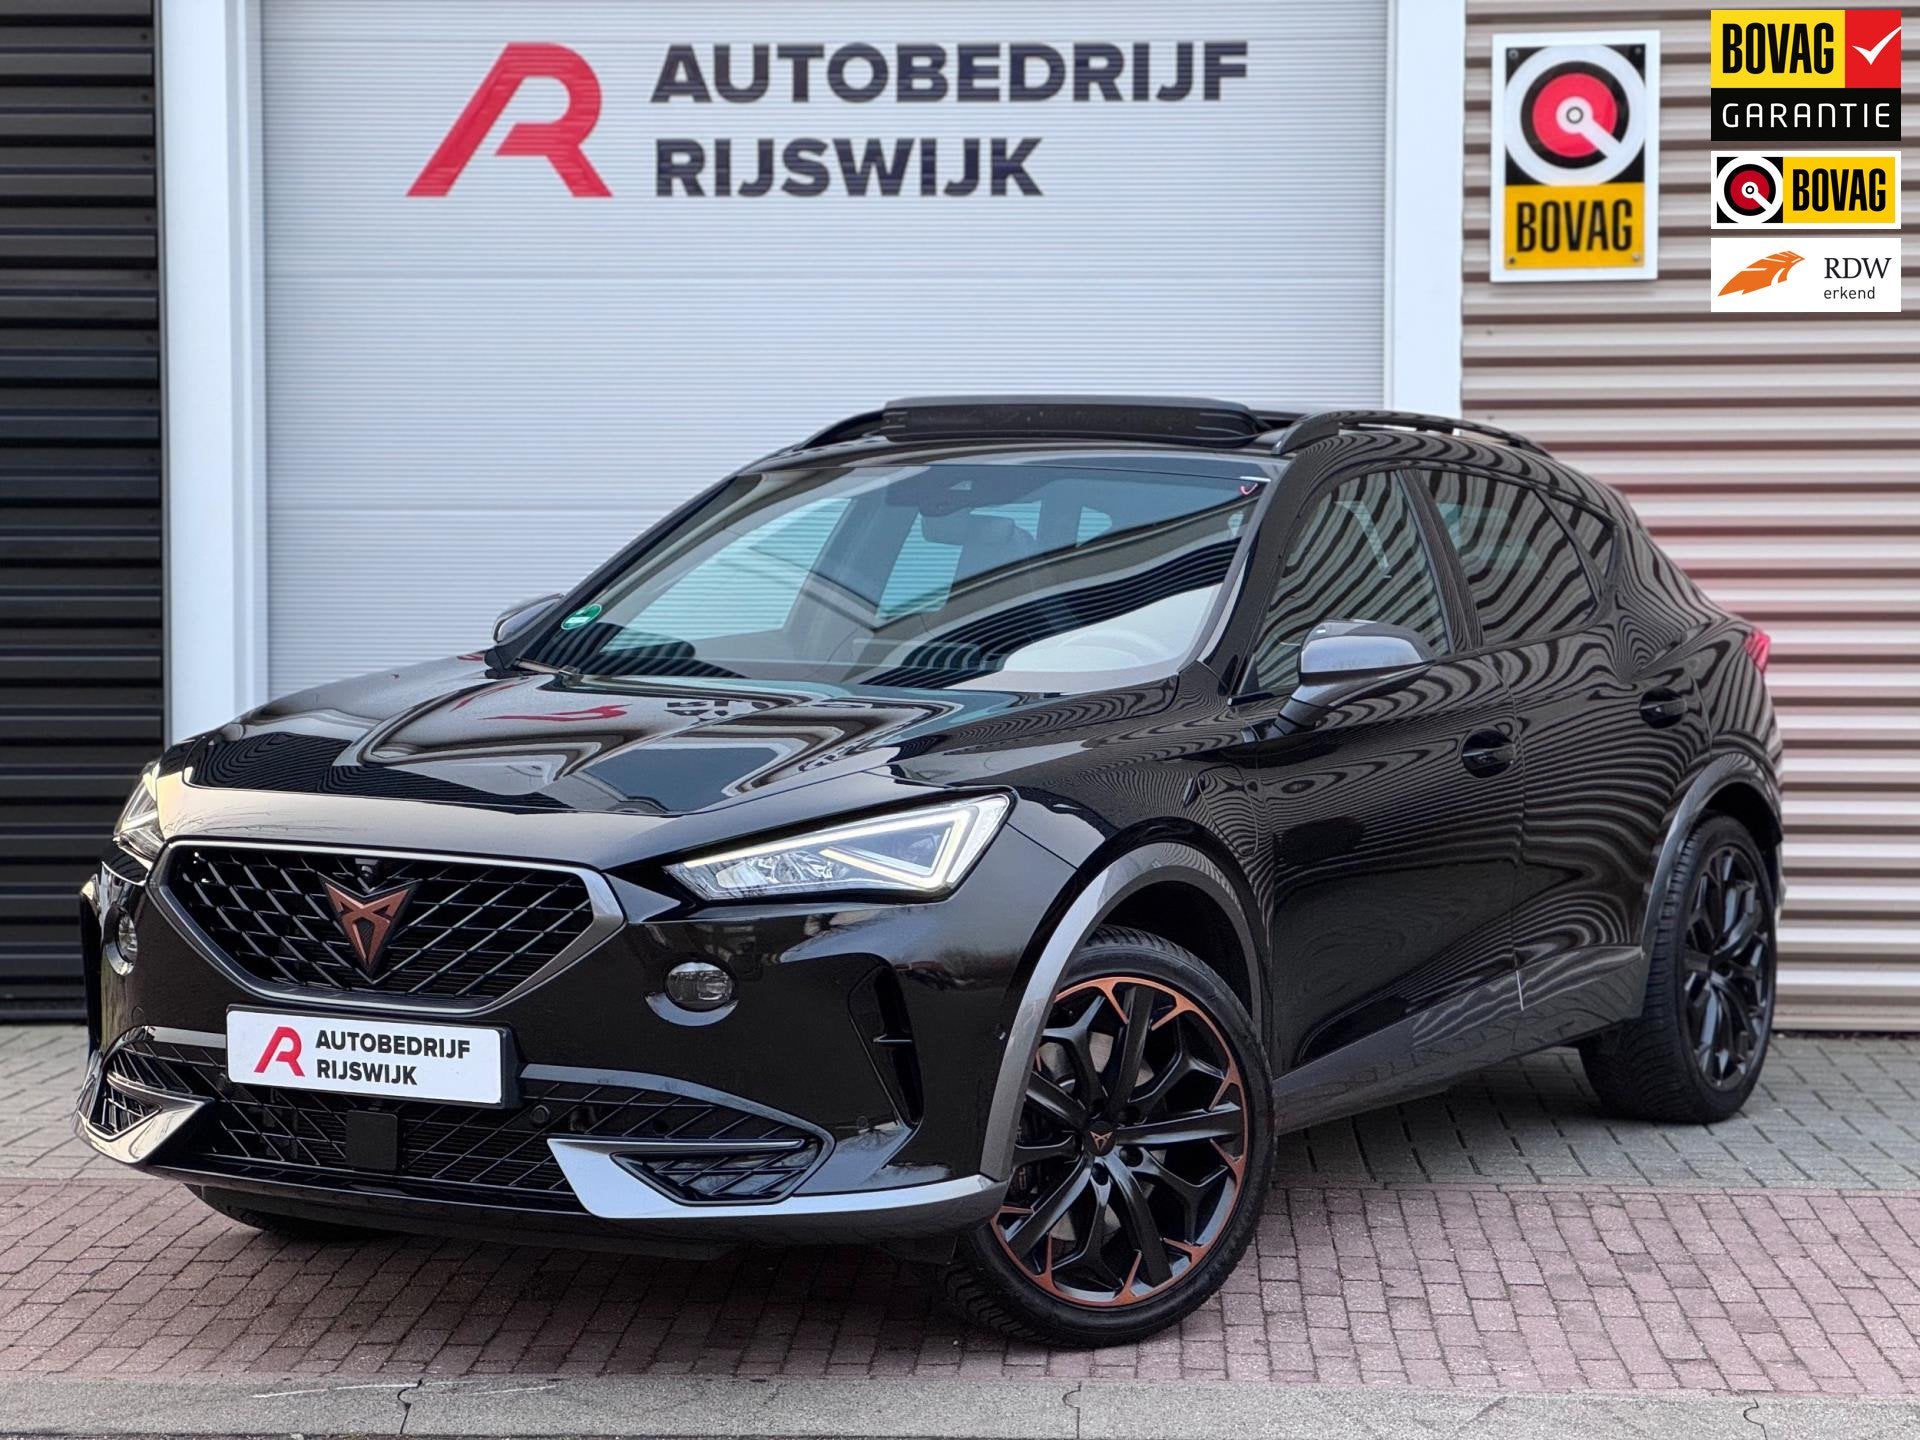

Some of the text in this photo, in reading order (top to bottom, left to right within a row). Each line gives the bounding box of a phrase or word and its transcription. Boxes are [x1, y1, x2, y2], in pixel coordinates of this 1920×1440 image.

[651, 41, 1248, 104] AUTOBEDRIJF
[655, 137, 1044, 197] RIJSWIJK
[1516, 199, 1633, 253] BOVAG
[315, 1029, 471, 1060] AUTOBEDRIJF
[316, 1059, 418, 1086] RIJSWIJK
